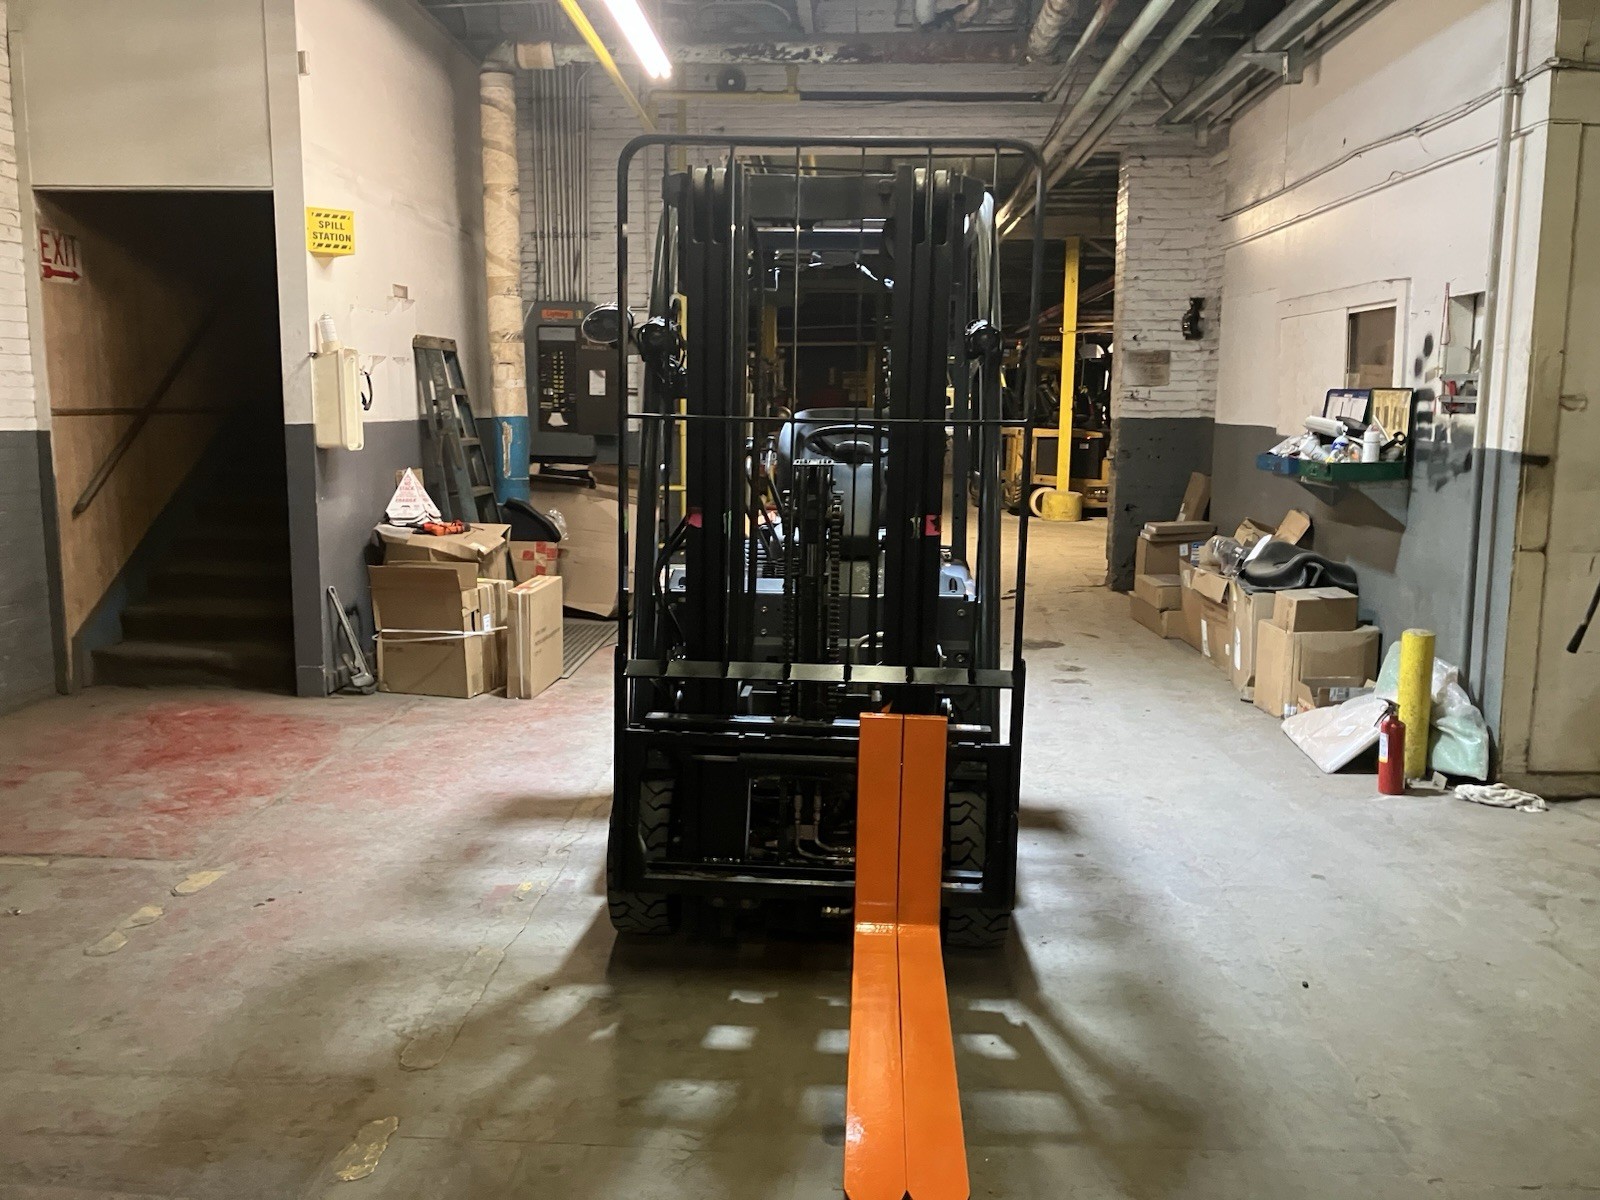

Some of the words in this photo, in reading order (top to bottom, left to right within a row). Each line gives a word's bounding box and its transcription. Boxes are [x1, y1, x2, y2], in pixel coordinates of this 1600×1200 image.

[318, 220, 346, 231] SPILL
[312, 231, 352, 242] STATION
[40, 229, 77, 268] EXIT
